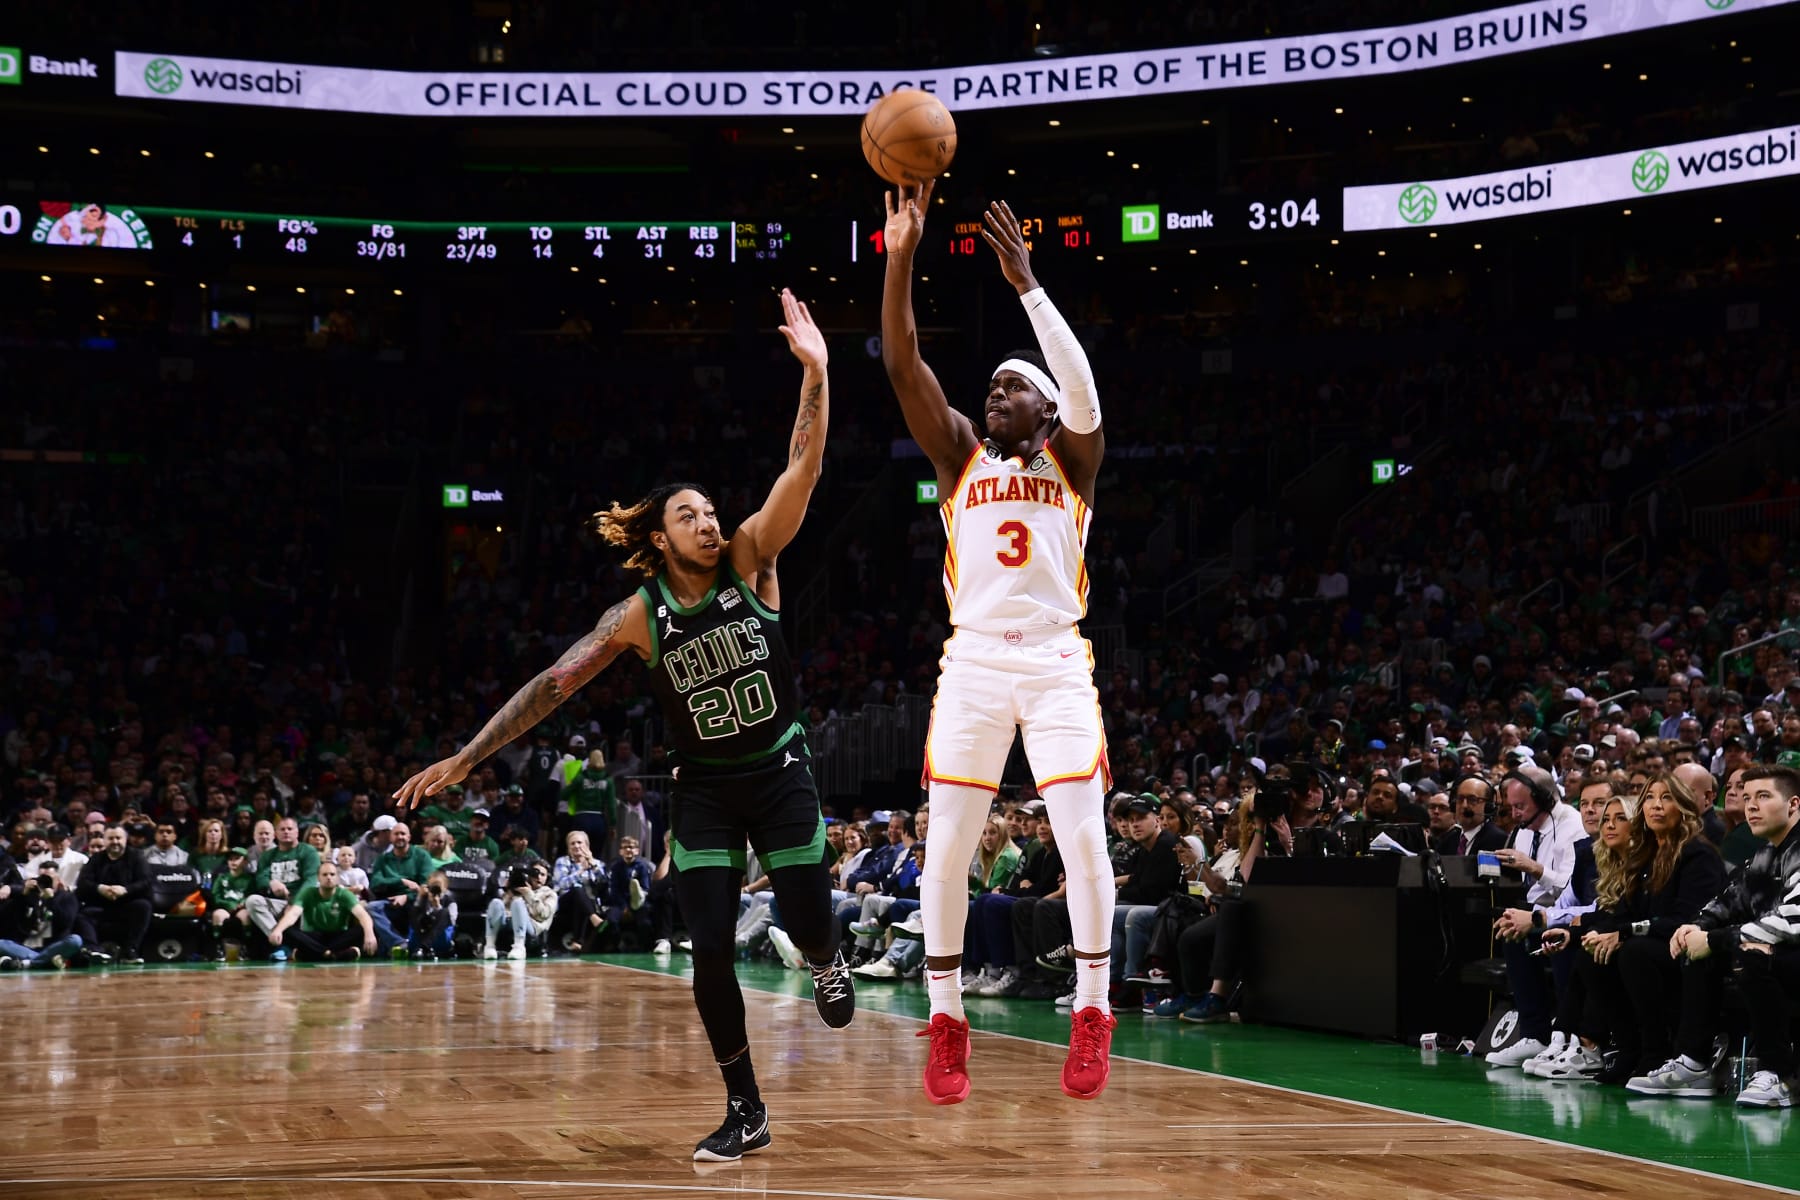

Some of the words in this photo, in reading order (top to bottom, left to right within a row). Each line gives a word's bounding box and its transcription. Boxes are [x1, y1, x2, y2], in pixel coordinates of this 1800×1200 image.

[29, 55, 98, 78] Bank
[425, 82, 602, 107] OFFICIAL
[616, 82, 747, 106] CLOUD
[953, 64, 1118, 101] PARTNER
[1133, 58, 1182, 85] OF
[1196, 50, 1267, 80] THE
[1284, 31, 1438, 72] BOSTON
[1454, 4, 1588, 52] BRUINS
[191, 69, 302, 95] wasabi
[1678, 131, 1797, 177] wasabi
[1446, 170, 1552, 211] wasabi
[1125, 211, 1156, 235] TD
[1166, 209, 1214, 230] Bank
[1249, 198, 1320, 231] 3:04
[220, 219, 245, 231] FLS
[278, 219, 318, 235] FG%
[371, 224, 395, 239] FG
[458, 226, 487, 240] 3PT
[530, 226, 553, 240] TO
[585, 226, 611, 240] STL
[636, 226, 668, 240] AST
[689, 226, 719, 240] REB
[767, 222, 782, 234] 89
[182, 232, 194, 247] 4
[233, 235, 242, 249] 1
[285, 238, 308, 252] 48
[357, 241, 406, 260] 39/81
[446, 244, 497, 263] 23/49
[533, 245, 553, 258] 14
[593, 244, 604, 259] 4
[644, 244, 663, 259] 31
[694, 244, 715, 259] 43
[769, 238, 783, 249] 91
[950, 238, 975, 255] 110
[1065, 231, 1090, 248] 101
[1374, 464, 1393, 479] TD
[445, 488, 467, 503] TD
[472, 489, 503, 502] Bank
[919, 484, 938, 499] TD
[965, 475, 1066, 510] ATLANTA
[996, 519, 1032, 568] 3
[716, 587, 740, 604] VISTA
[721, 595, 742, 611] PRINT
[657, 605, 667, 618] 6
[664, 617, 770, 694] CELTICS
[688, 669, 777, 740] 20
